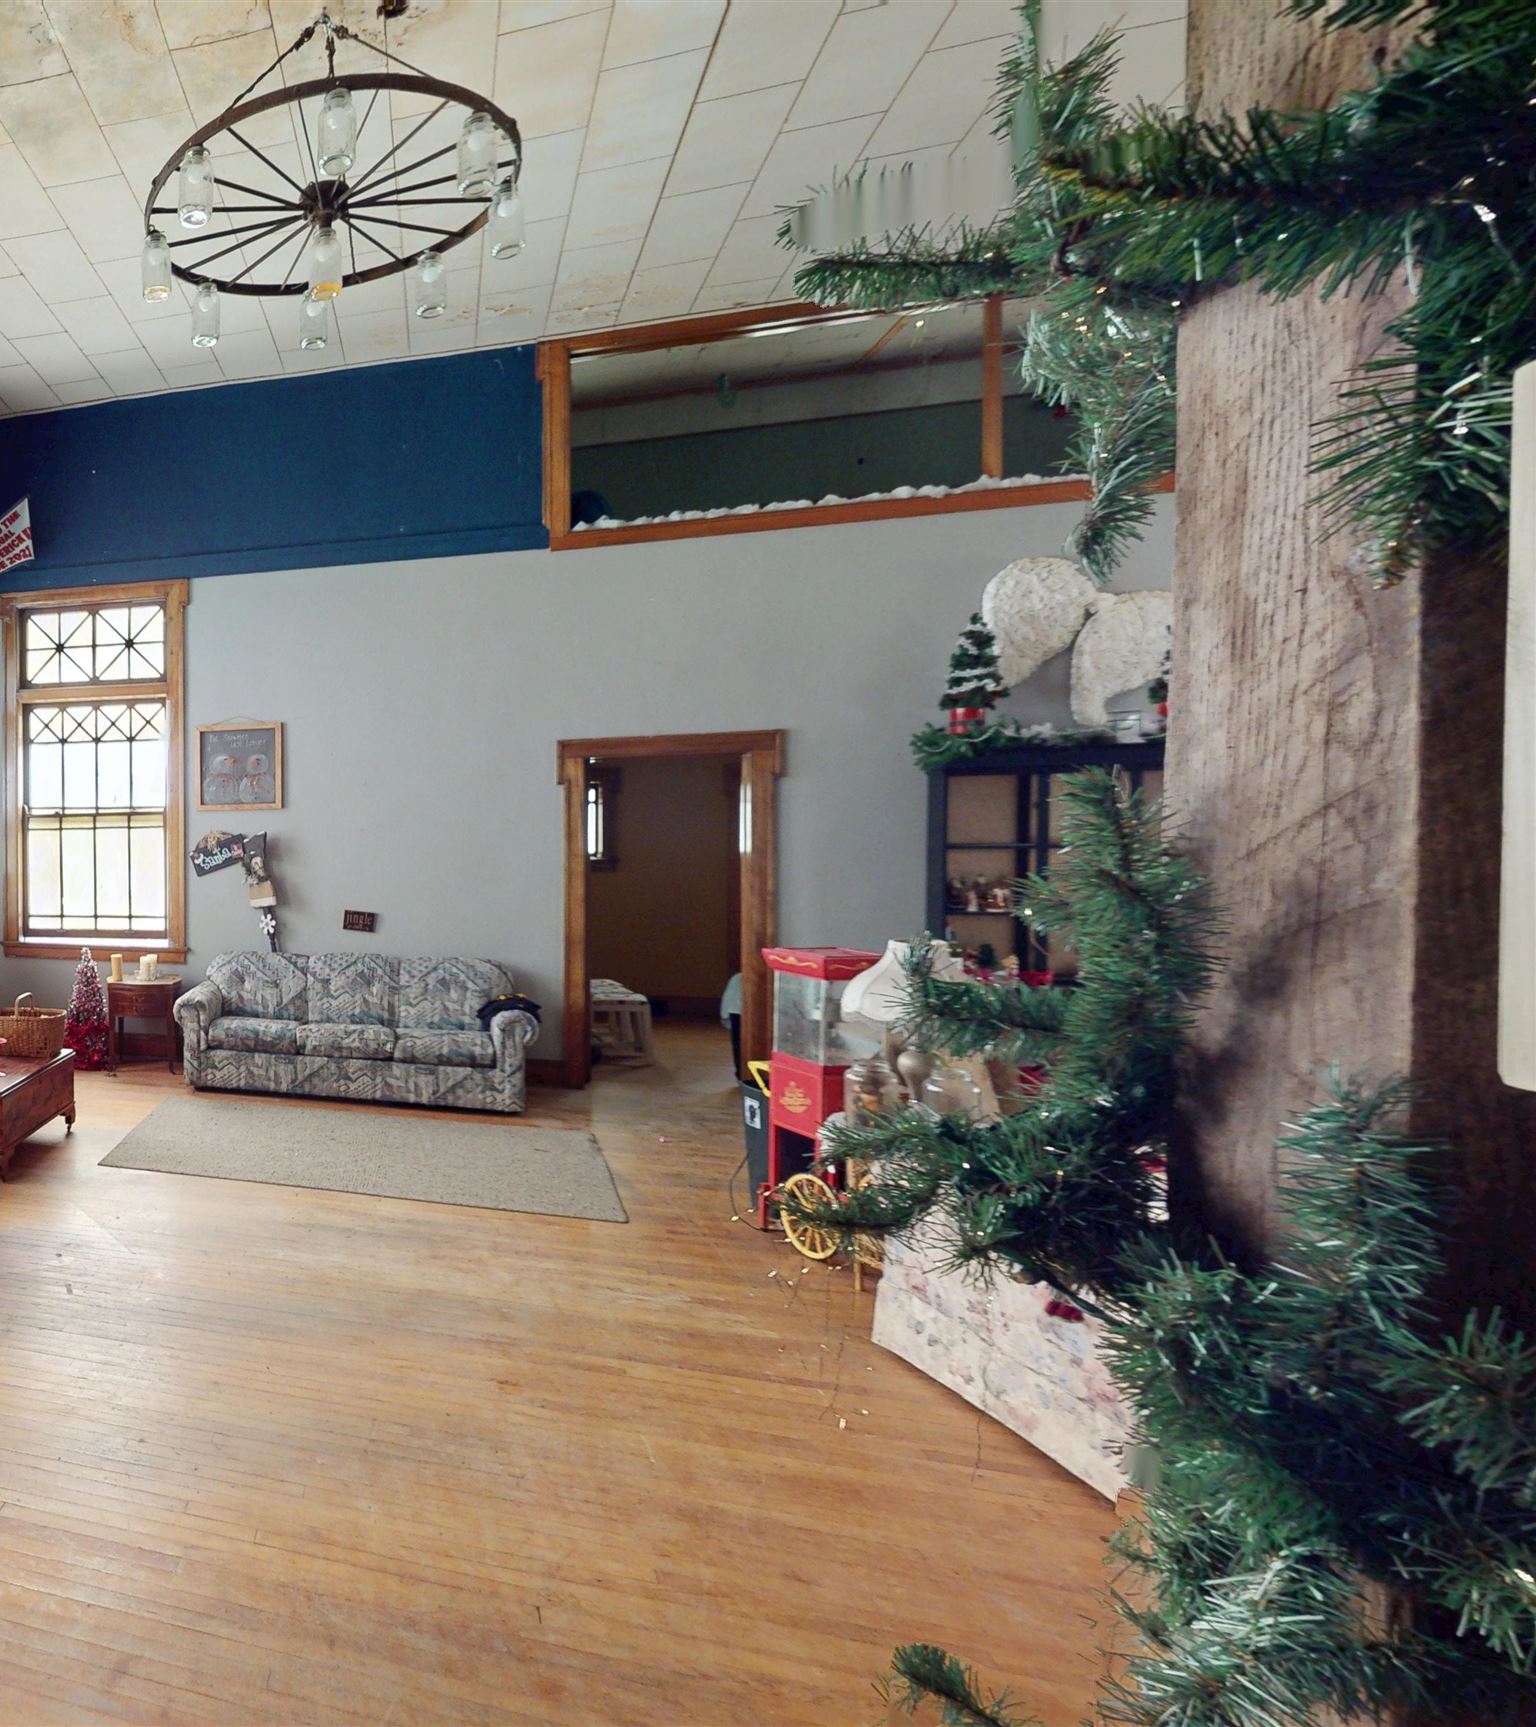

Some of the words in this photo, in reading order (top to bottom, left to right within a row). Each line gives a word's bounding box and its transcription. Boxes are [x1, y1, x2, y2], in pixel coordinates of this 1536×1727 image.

[0, 510, 21, 529] THE
[6, 545, 32, 565] 2021
[200, 846, 231, 870] Santa
